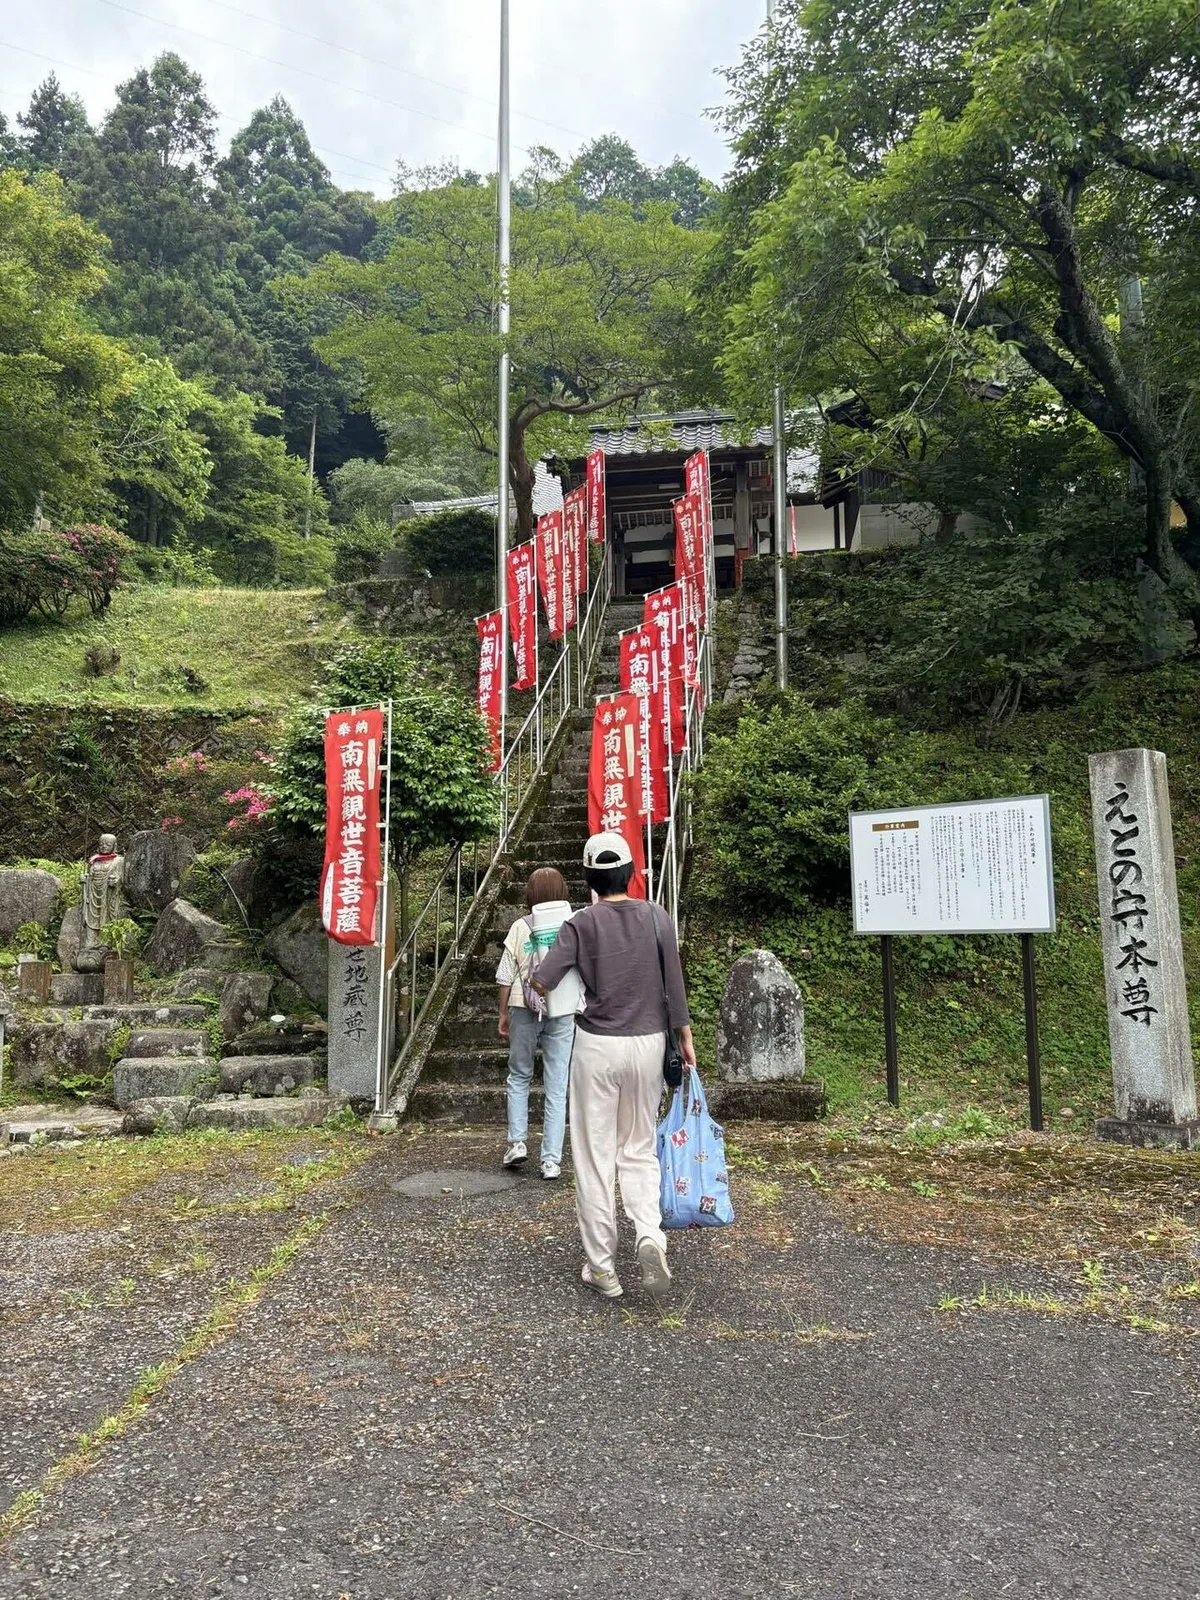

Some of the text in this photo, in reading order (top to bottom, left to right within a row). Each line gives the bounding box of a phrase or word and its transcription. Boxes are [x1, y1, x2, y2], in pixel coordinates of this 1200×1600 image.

[337, 720, 369, 736] 奉納
[602, 706, 627, 725] 奉納
[335, 740, 367, 933] 南無観世音菩薩
[1104, 781, 1159, 1026] えとの守本尊
